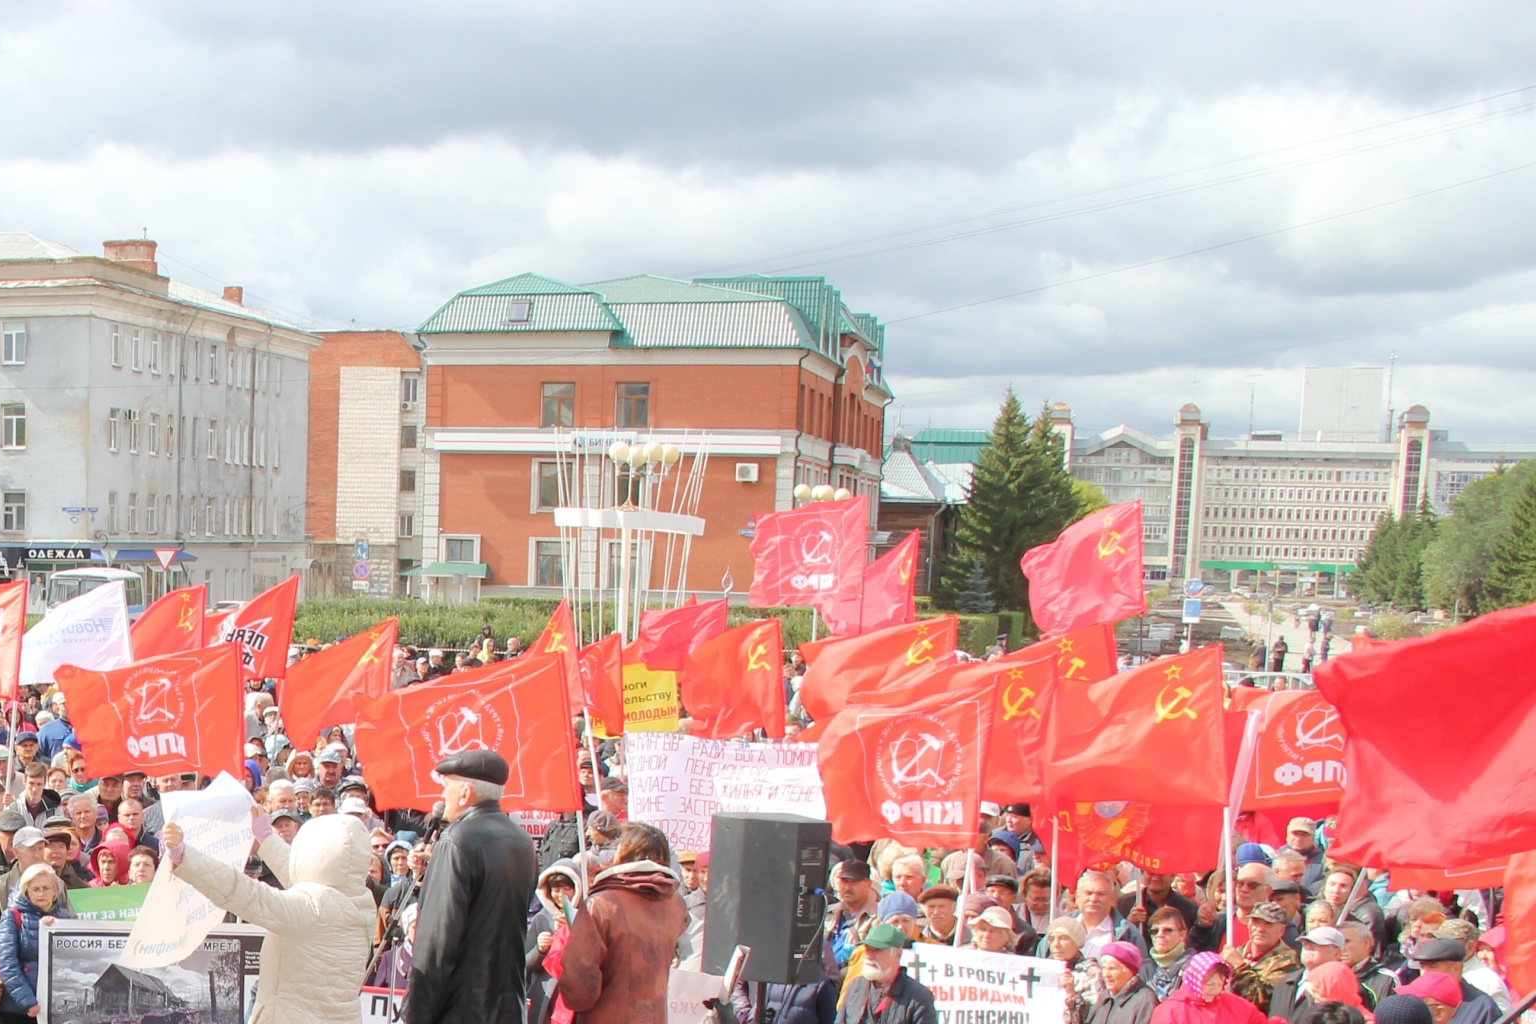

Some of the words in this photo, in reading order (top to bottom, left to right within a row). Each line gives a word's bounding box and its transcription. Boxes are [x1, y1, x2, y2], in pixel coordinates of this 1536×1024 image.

[589, 438, 633, 447] БИНБНК
[28, 549, 85, 559] ОДЕЖДА
[624, 690, 672, 705] ельству
[692, 744, 725, 760] РАДИ
[735, 748, 767, 764] БОГА
[628, 754, 667, 773] ЕДНОЙ
[631, 776, 679, 794] ТАЛАСЬ
[690, 778, 714, 796] БЕЗ
[721, 783, 764, 799] ЖИЛЬЯ
[75, 910, 99, 921] тит
[101, 909, 116, 920] за
[55, 939, 102, 949] РОССИЯ
[944, 963, 954, 978] В
[959, 966, 1006, 986] ГРОБУ
[959, 986, 1026, 1006] УВИДИМ
